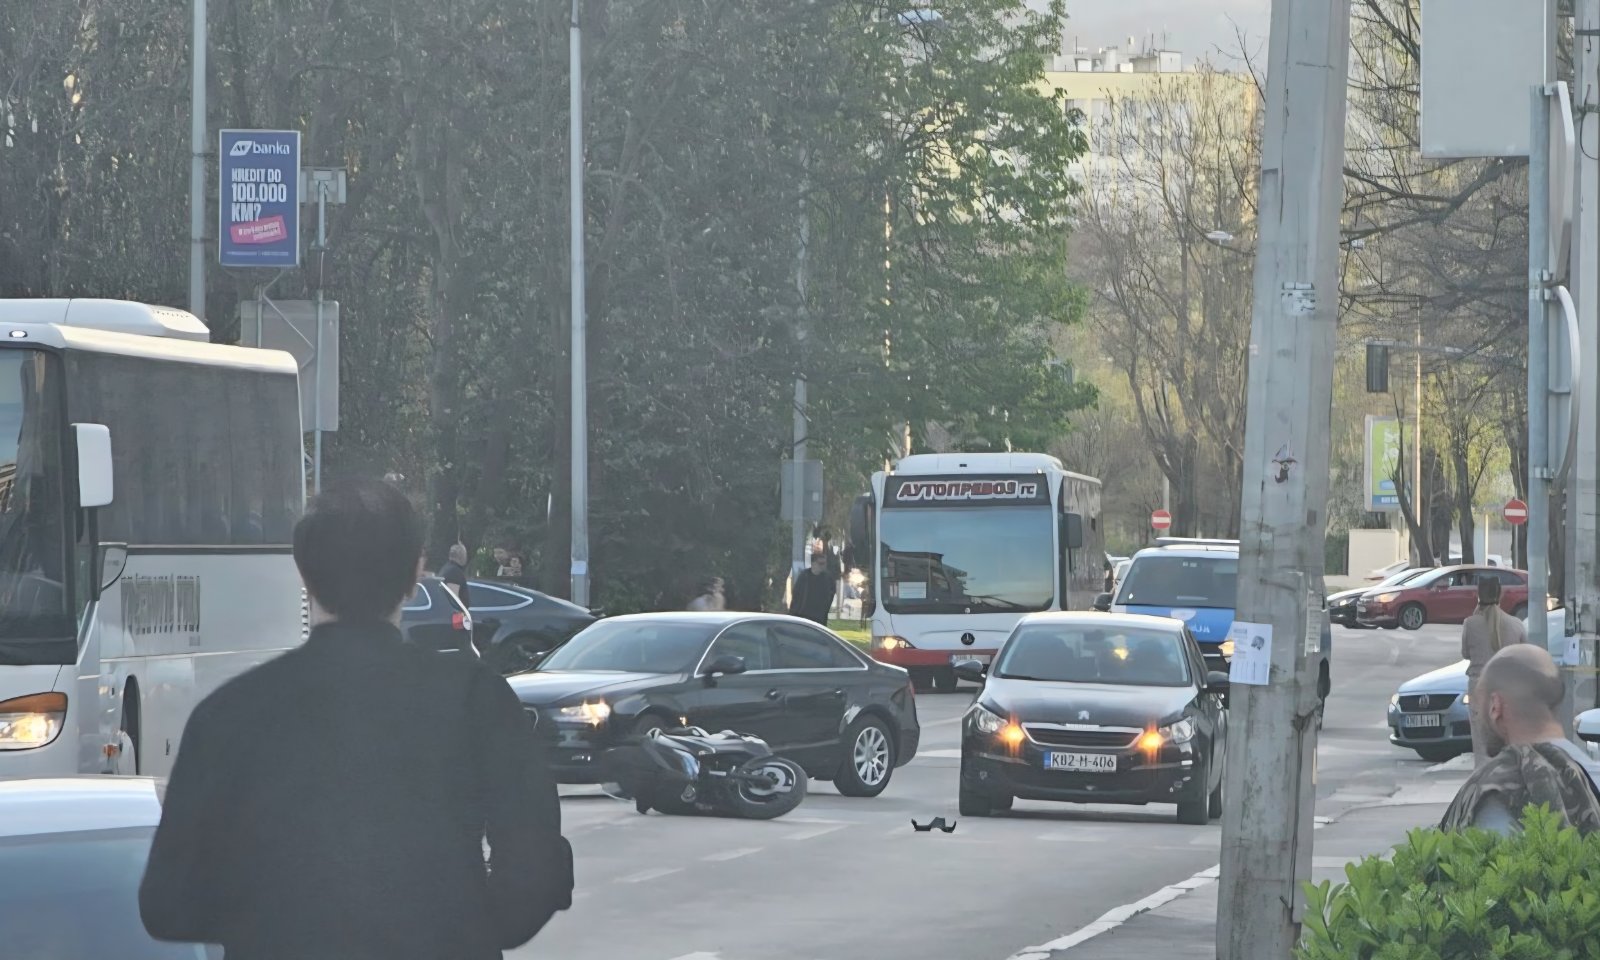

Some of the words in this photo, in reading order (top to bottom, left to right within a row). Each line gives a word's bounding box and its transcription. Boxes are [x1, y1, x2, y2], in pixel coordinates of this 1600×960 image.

[253, 140, 290, 155] banka
[231, 168, 266, 182] KREDIT
[267, 168, 282, 183] DO
[232, 183, 287, 203] 100.000
[231, 202, 261, 222] KM?
